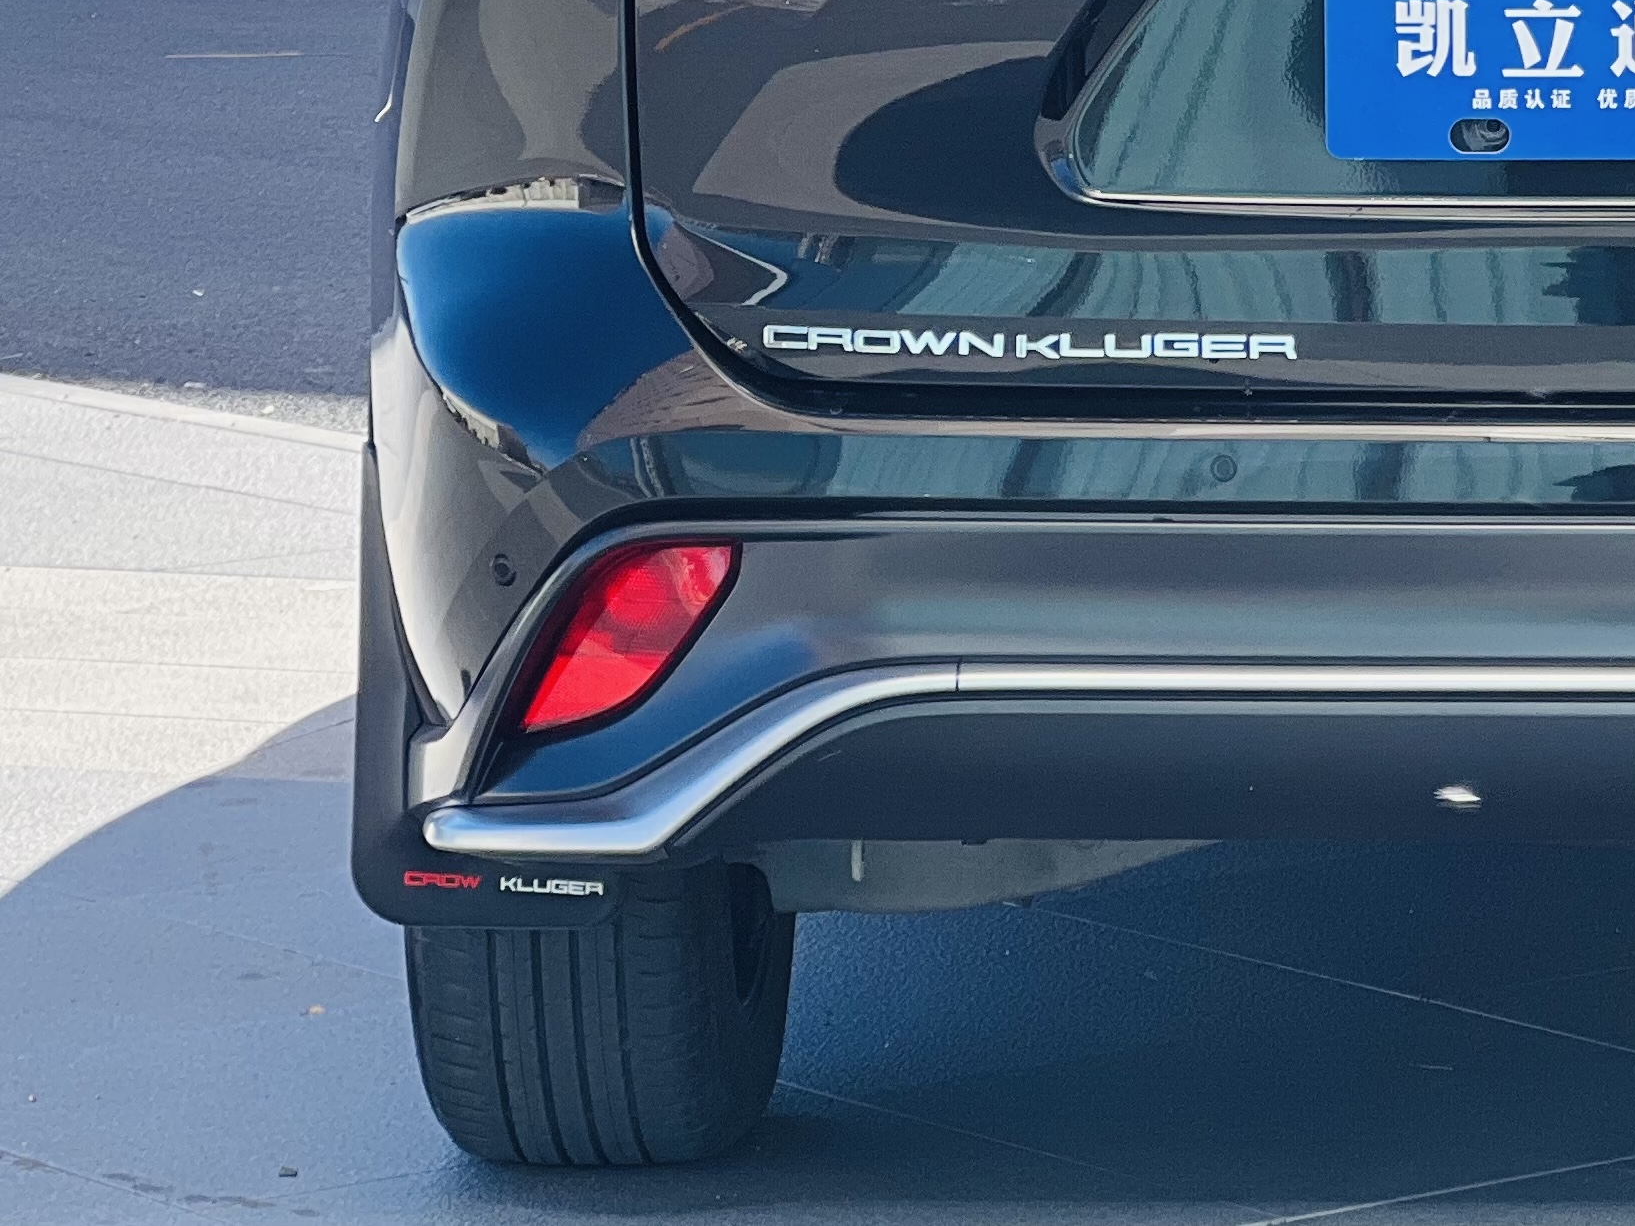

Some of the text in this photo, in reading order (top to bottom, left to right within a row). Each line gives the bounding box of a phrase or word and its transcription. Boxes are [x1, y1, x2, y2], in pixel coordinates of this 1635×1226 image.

[1472, 88, 1573, 110] 品质认证
[763, 324, 1298, 360] CROWN KLUGER
[404, 870, 604, 895] CROW KLUGER
